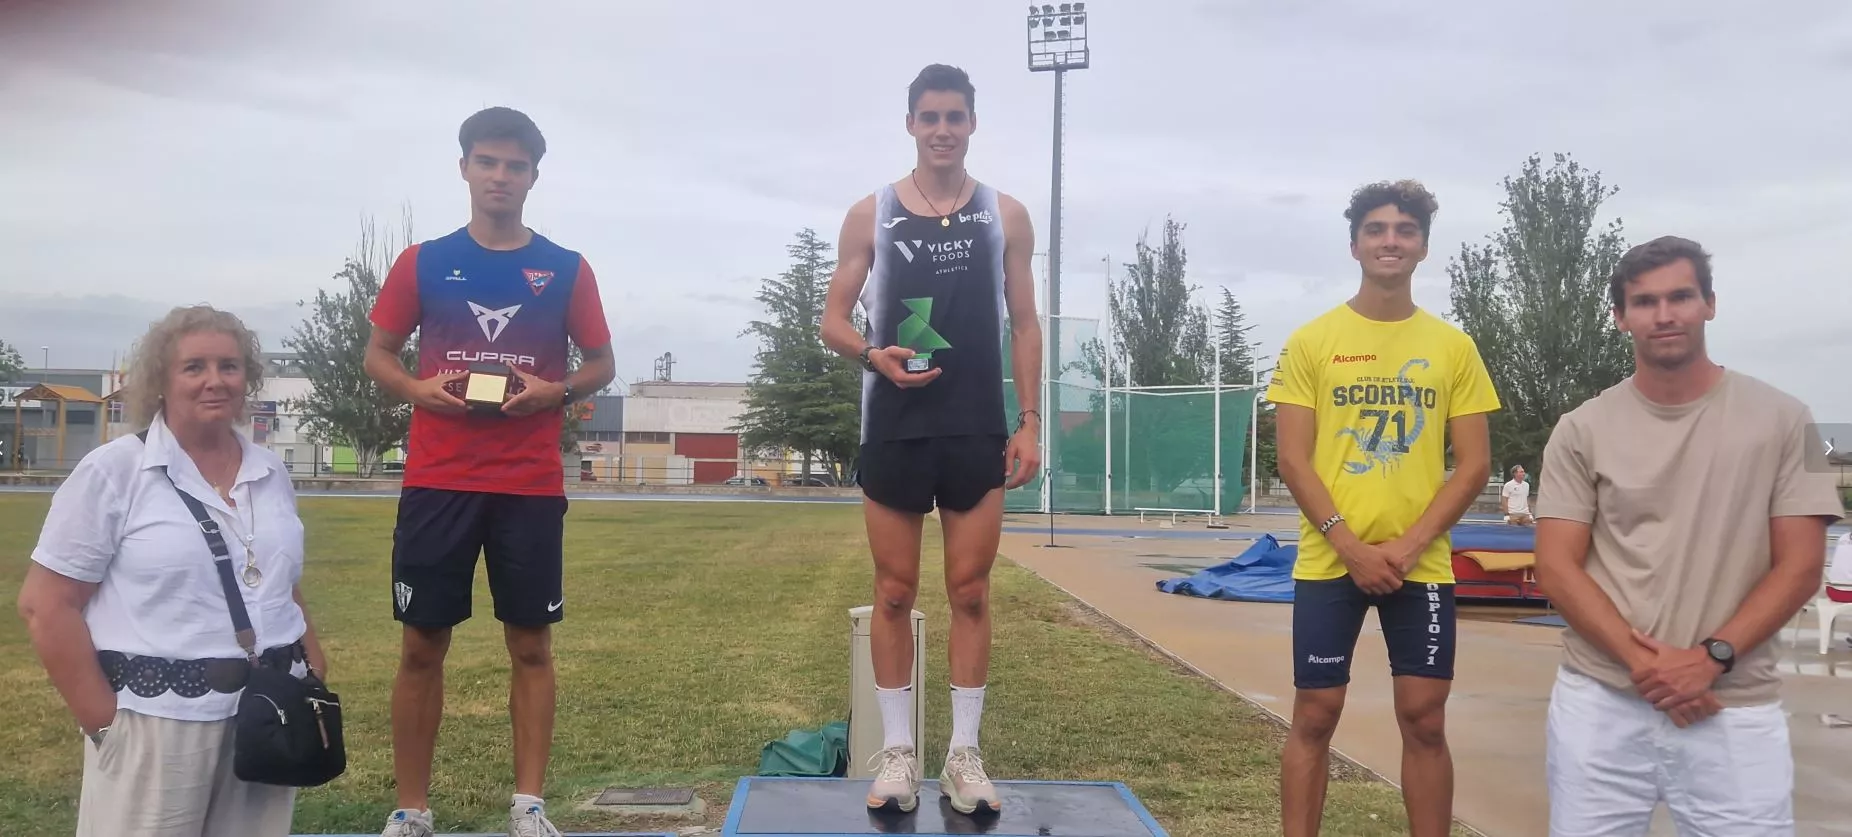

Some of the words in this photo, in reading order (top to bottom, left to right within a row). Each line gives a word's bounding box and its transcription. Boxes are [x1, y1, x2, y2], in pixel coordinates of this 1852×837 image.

[959, 213, 971, 223] be
[927, 239, 974, 253] VICKY
[932, 250, 970, 262] FOODS
[446, 350, 535, 366] CUPRA
[1332, 354, 1377, 364] Alcampo
[1332, 384, 1437, 409] SCORPIO
[1359, 409, 1410, 454] 71
[1308, 654, 1345, 664] Alcampo
